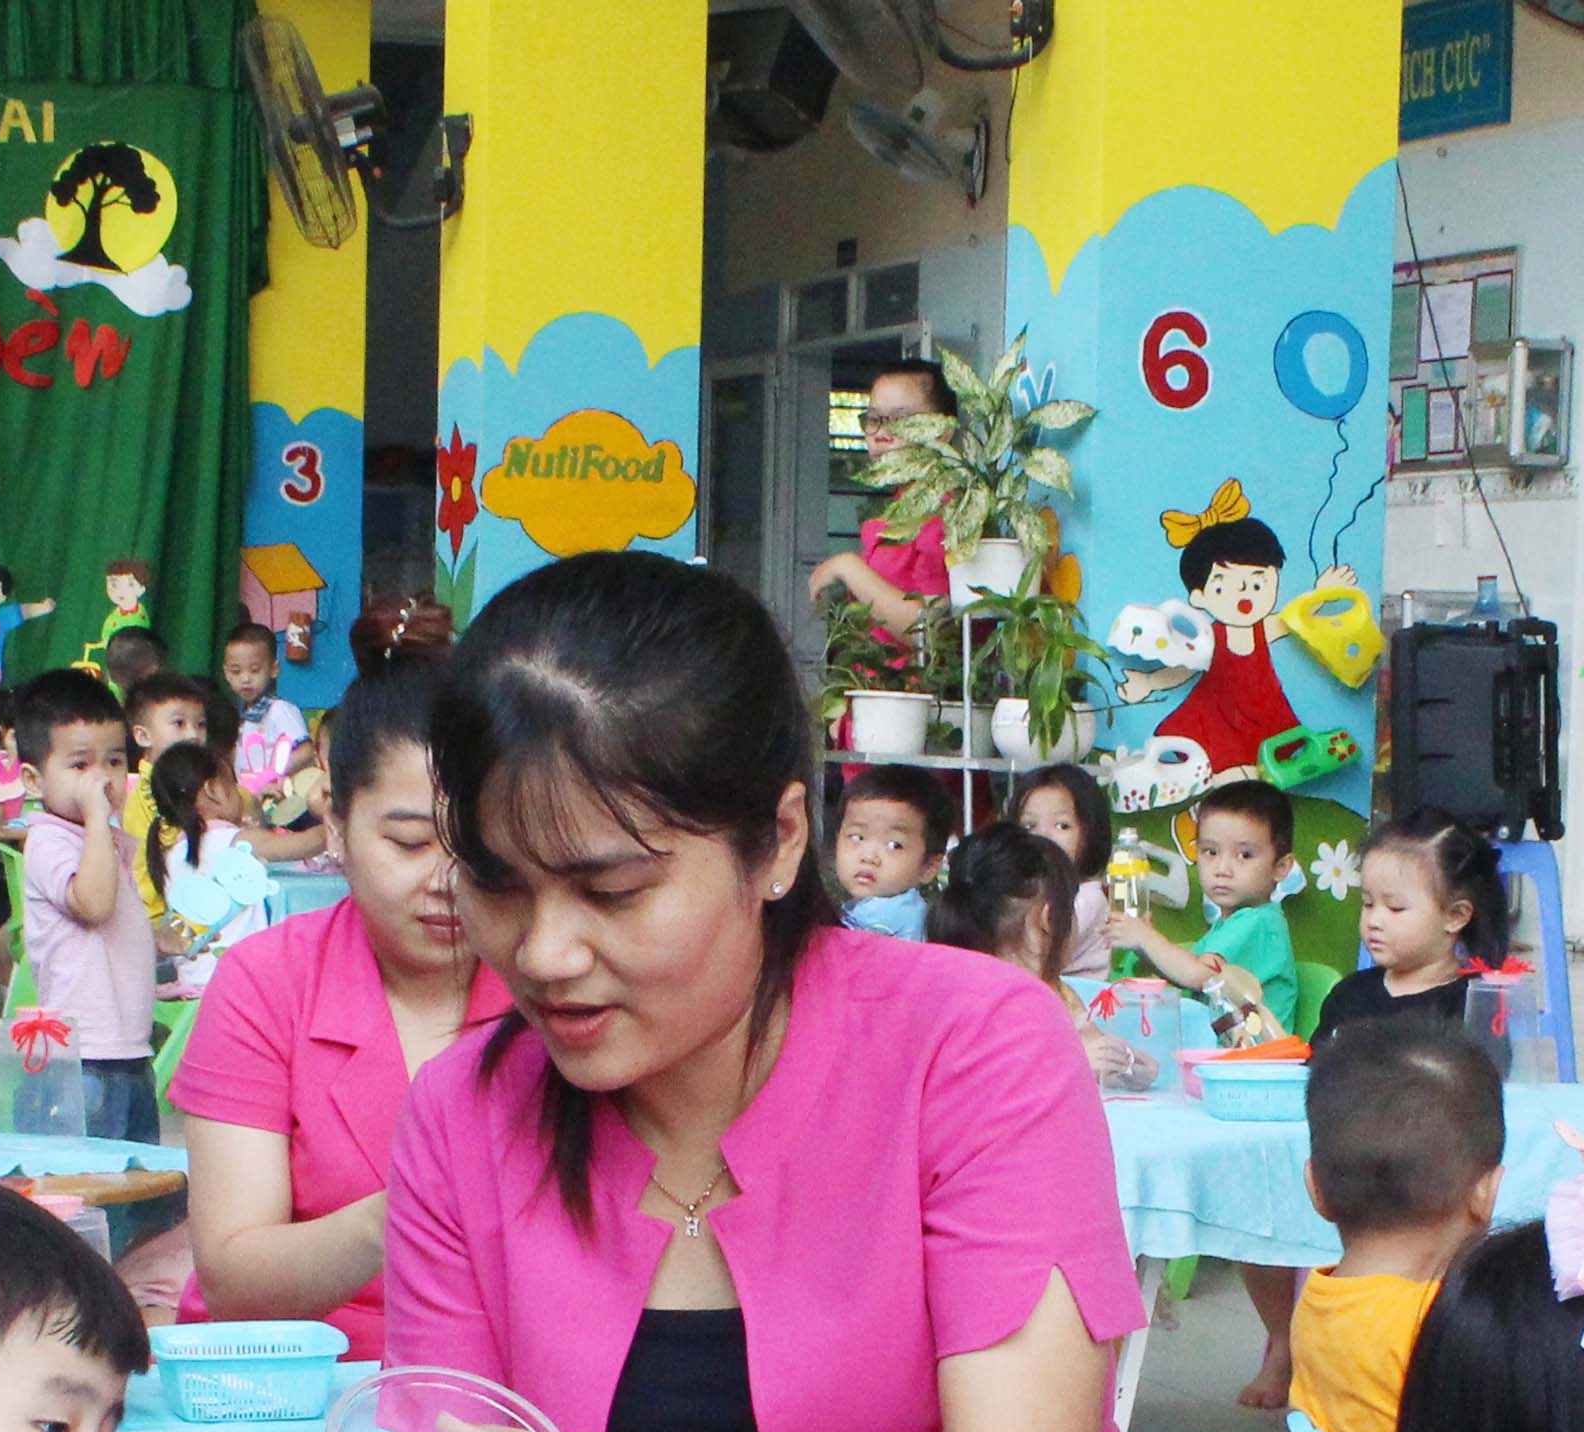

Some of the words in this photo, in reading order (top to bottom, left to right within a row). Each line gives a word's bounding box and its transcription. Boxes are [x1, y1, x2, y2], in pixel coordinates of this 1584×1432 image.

[1140, 307, 1212, 411] 6
[280, 440, 325, 507] 3
[503, 442, 667, 484] NutiFood
